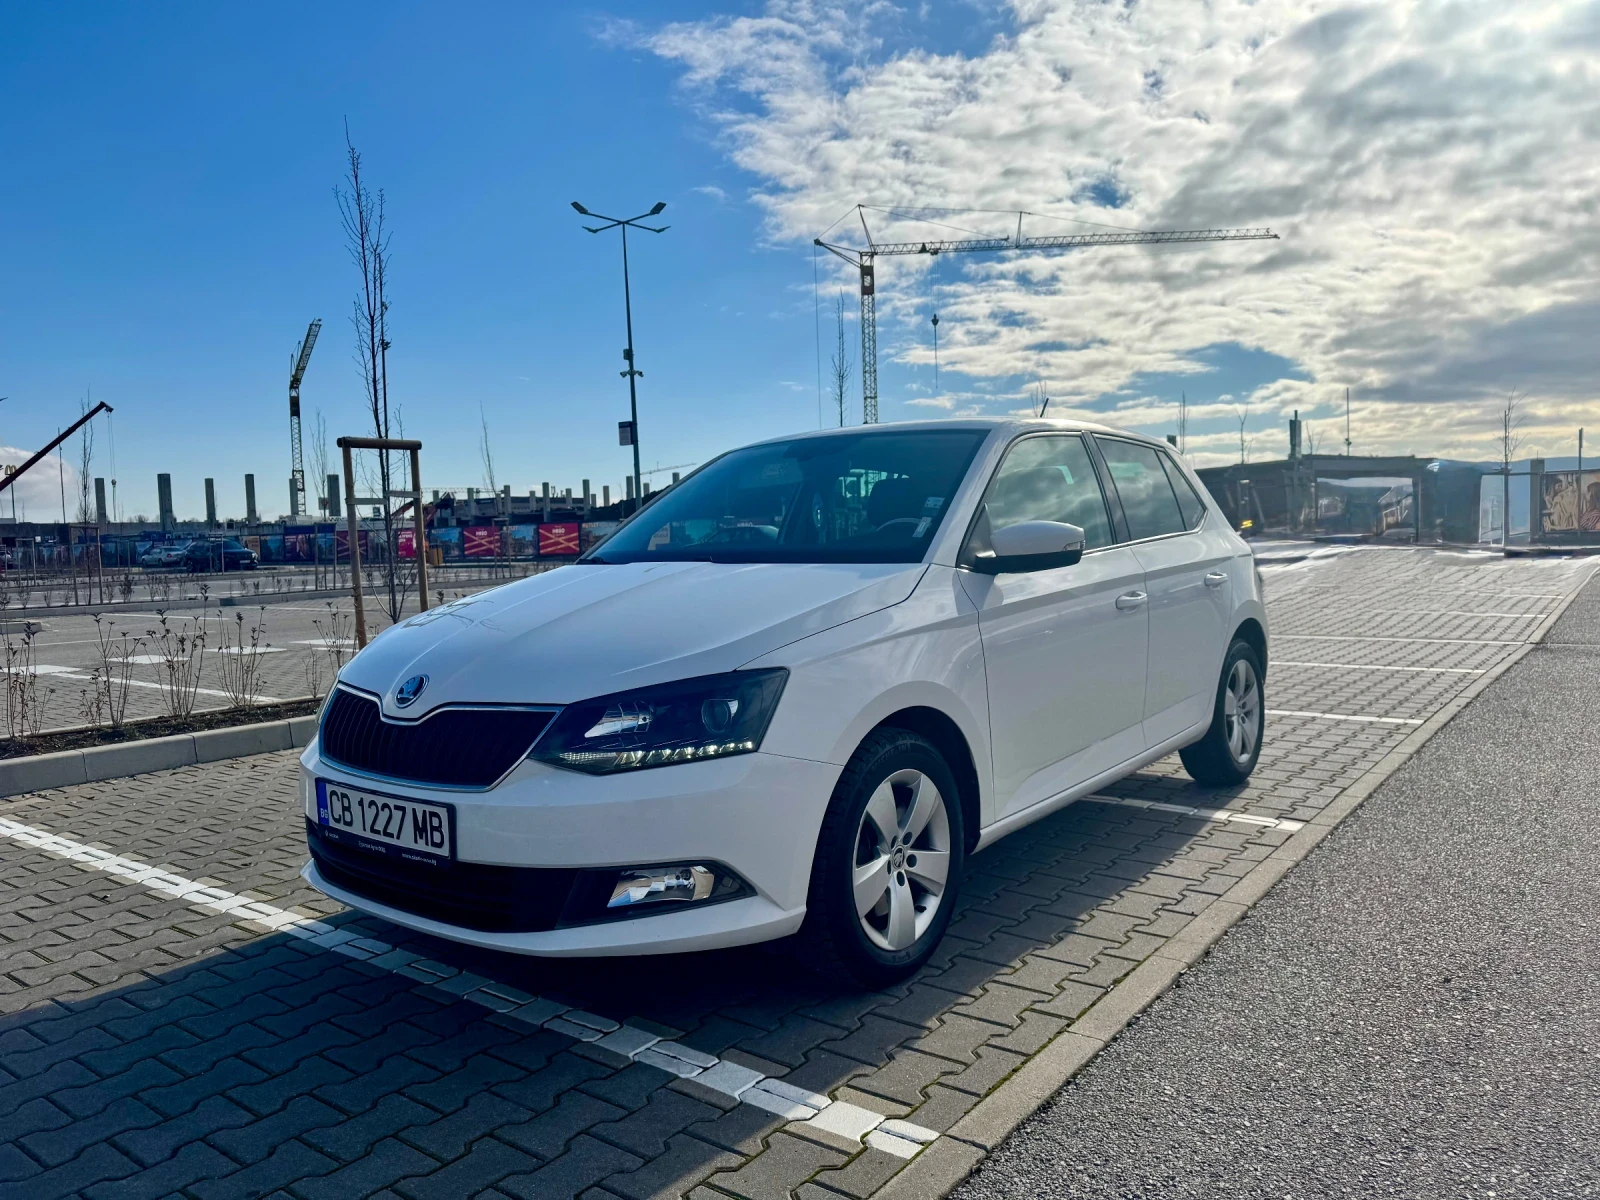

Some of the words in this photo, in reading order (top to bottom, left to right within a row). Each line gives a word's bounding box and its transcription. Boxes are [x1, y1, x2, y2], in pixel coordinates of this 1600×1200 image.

[320, 807, 329, 819] BG
[329, 790, 354, 827] CB
[358, 797, 407, 840] 1227
[412, 807, 445, 849] MB
